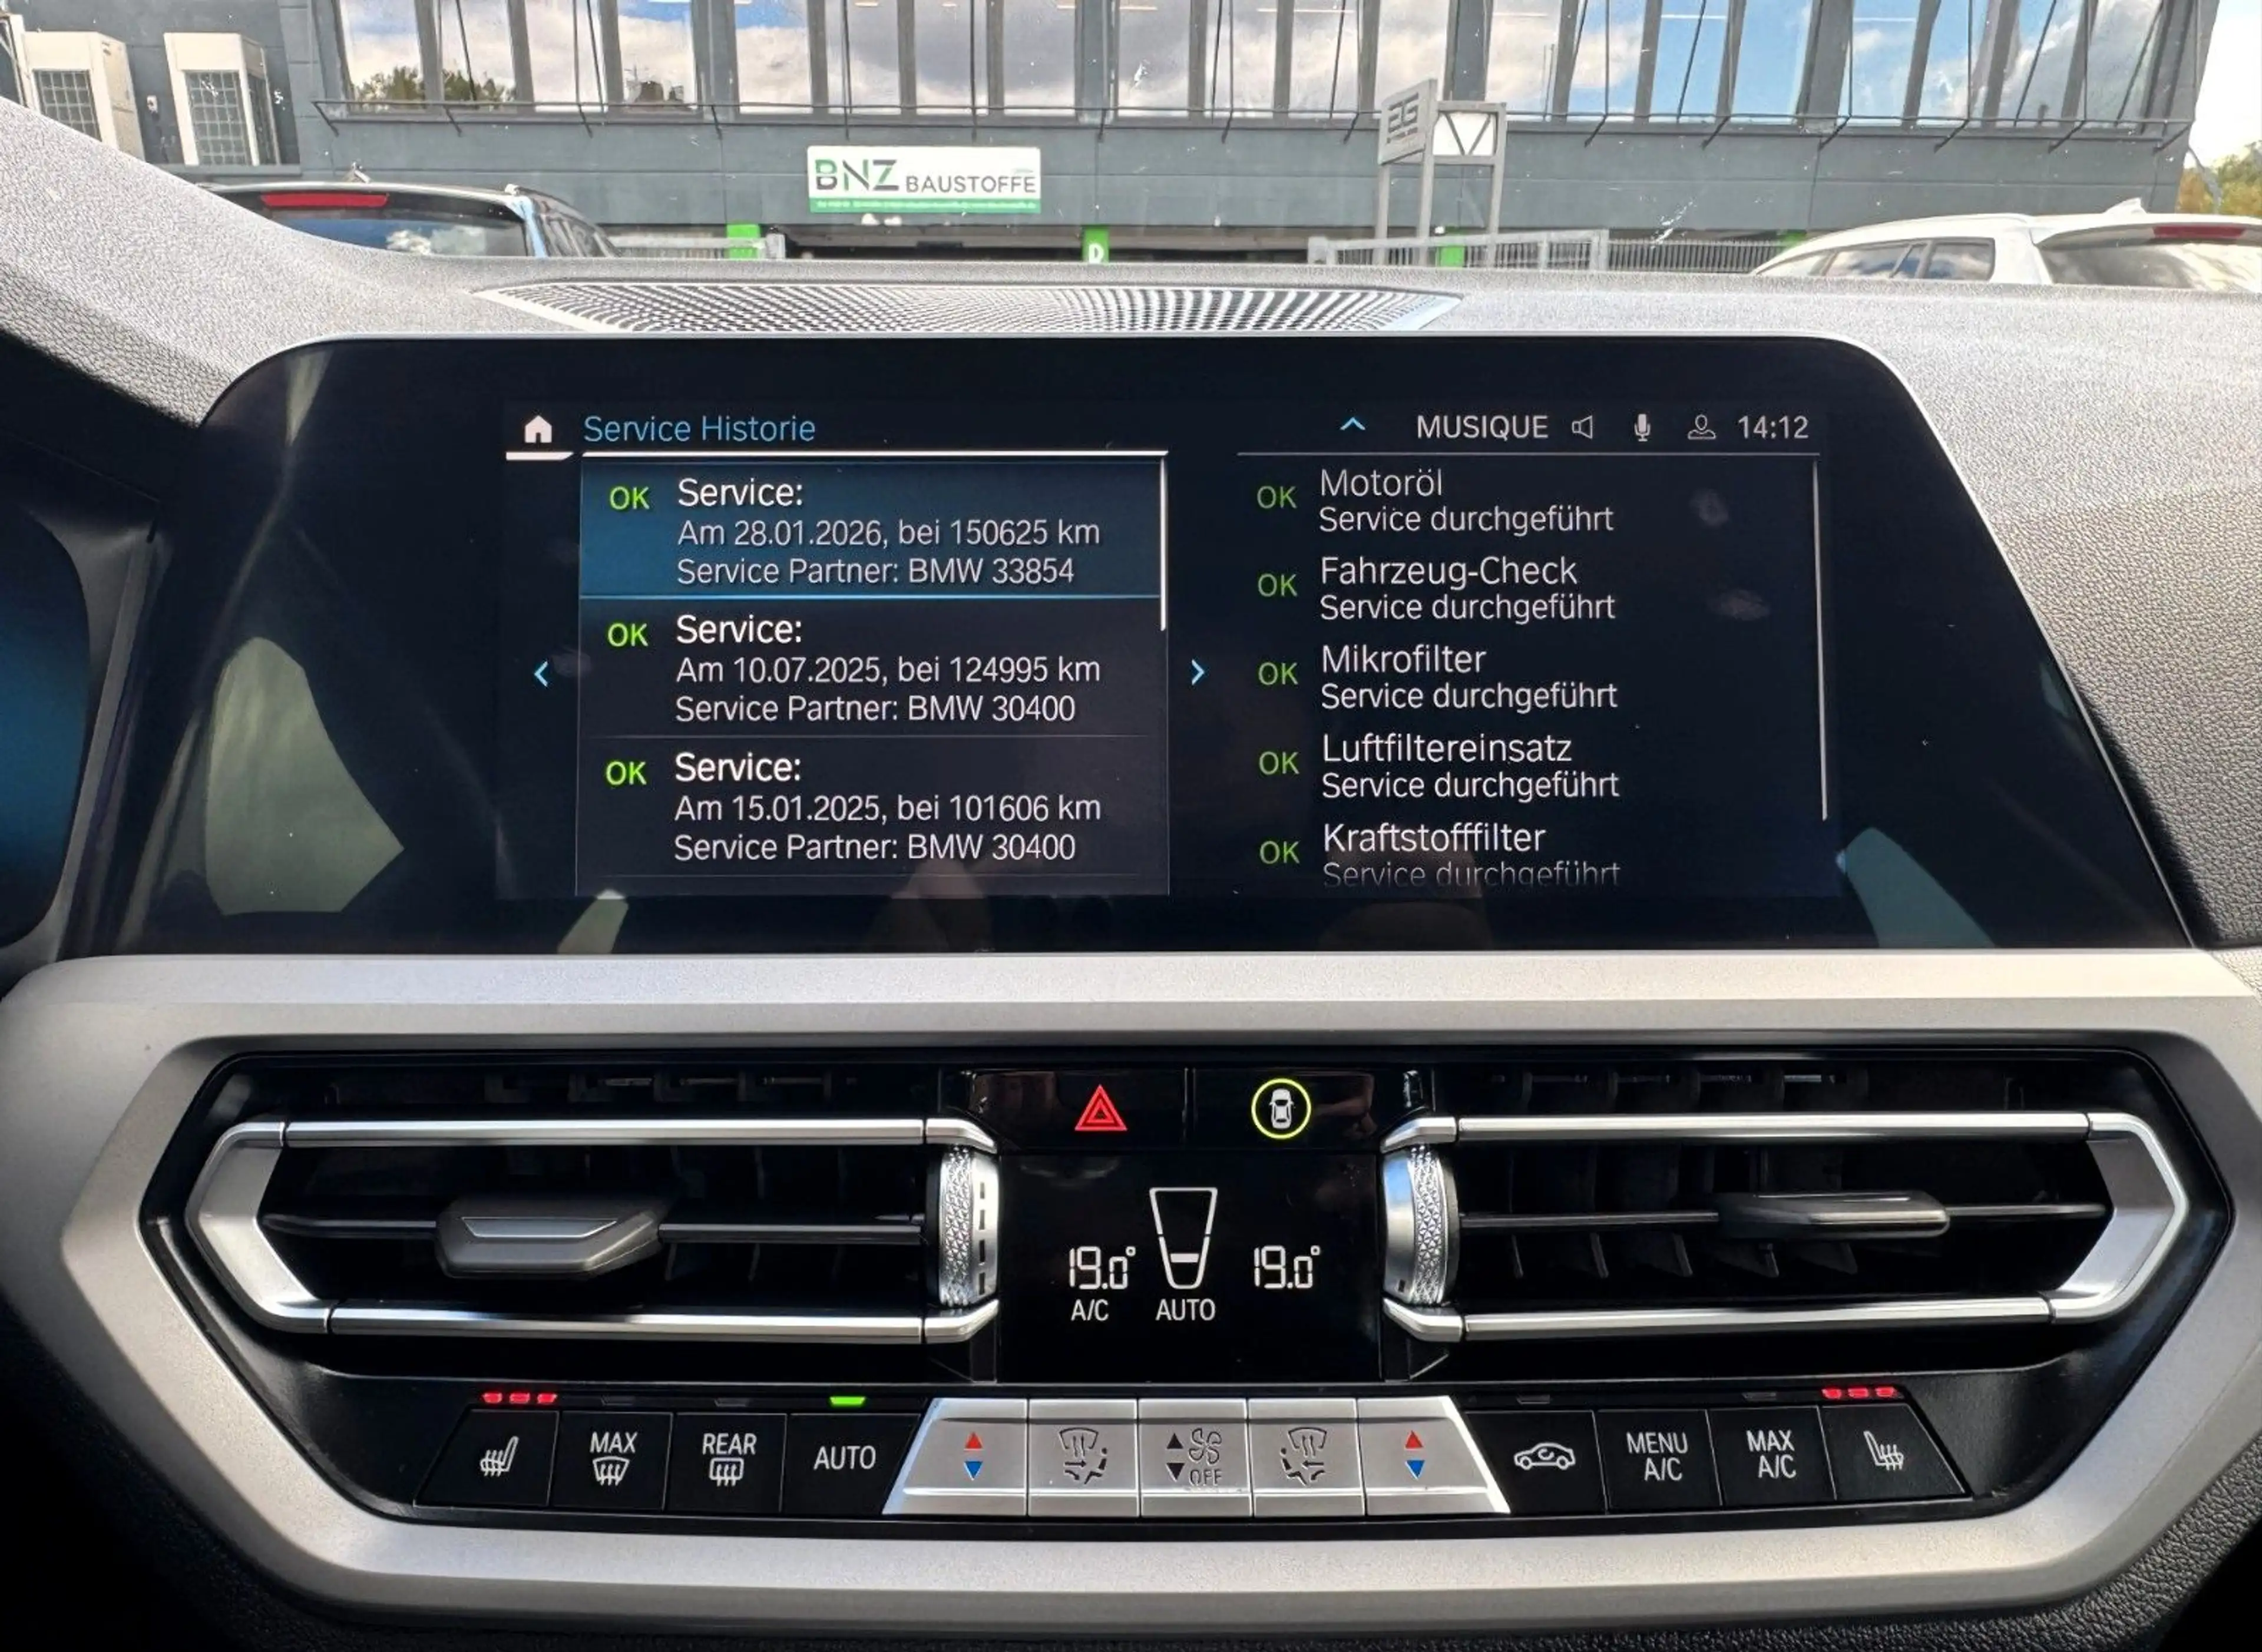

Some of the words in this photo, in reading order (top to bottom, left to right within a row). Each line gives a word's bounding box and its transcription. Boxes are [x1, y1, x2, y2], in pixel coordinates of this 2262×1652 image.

[815, 158, 899, 191] BNZ
[906, 175, 1036, 193] BAUSTOFFE
[584, 415, 691, 442] Service
[702, 415, 815, 442] Historie
[1417, 415, 1549, 442] MUSIQUE
[1738, 415, 1809, 439] 14:12
[678, 478, 802, 507] Service:
[1321, 468, 1442, 497] Motoröl
[610, 486, 650, 510] OK
[1257, 485, 1297, 509] OK
[677, 519, 725, 545] Am
[734, 519, 888, 549] 28.01.2026,
[899, 519, 940, 545] bei
[951, 519, 1048, 546] 150625
[1059, 518, 1099, 544] km
[1320, 505, 1421, 532] Service
[1430, 505, 1614, 537] durchgeführt
[677, 557, 779, 585] Service
[789, 558, 898, 584] Partner:
[909, 557, 984, 583] BMW
[992, 557, 1074, 584] 33854
[1322, 555, 1578, 591] Fahrzeug-Check
[1258, 573, 1298, 597] OK
[1320, 594, 1423, 620] Service
[1432, 593, 1616, 625] durchgeführt
[607, 623, 648, 647] OK
[677, 614, 801, 644] Service:
[676, 657, 723, 683] Am
[733, 656, 888, 687] 10.07.2025,
[898, 655, 939, 683] bei
[950, 656, 1048, 683] 124995
[1059, 655, 1100, 681] km
[1322, 644, 1487, 673] Mikrofilter
[1258, 662, 1298, 686] OK
[676, 695, 779, 722] Service
[788, 695, 897, 721] Partner:
[909, 695, 984, 721] BMW
[992, 695, 1076, 721] 30400
[1321, 682, 1424, 709] Service
[1433, 681, 1618, 714] durchgeführt
[1324, 732, 1572, 763] Luftfiltereinsatz
[606, 760, 647, 785] OK
[675, 751, 801, 782] Service:
[1259, 751, 1299, 775] OK
[1322, 771, 1425, 798] Service
[1434, 771, 1620, 803] durchgeführt
[674, 795, 722, 821] Am
[732, 794, 887, 825] 15.01.2025,
[898, 794, 939, 821] bei
[950, 794, 1049, 822] 101606
[1059, 794, 1101, 820] km
[674, 833, 778, 861] Service
[787, 834, 897, 860] Partner:
[908, 833, 984, 859] BMW
[992, 833, 1076, 860] 30400
[1324, 822, 1546, 852] Kraftstofffilter
[1259, 840, 1299, 864] OK
[1323, 861, 1426, 888] Service
[1436, 860, 1621, 887] durchgeführt
[1071, 1299, 1109, 1321] A/C
[1155, 1298, 1216, 1321] AUTO
[590, 1431, 637, 1454] MAX
[702, 1433, 757, 1455] REAR
[1626, 1432, 1688, 1454] MENU
[1747, 1429, 1795, 1452] MAX
[813, 1445, 876, 1470] AUTO
[1644, 1457, 1682, 1481] A/C
[1758, 1454, 1797, 1479] A/C
[1189, 1469, 1223, 1486] OFF
